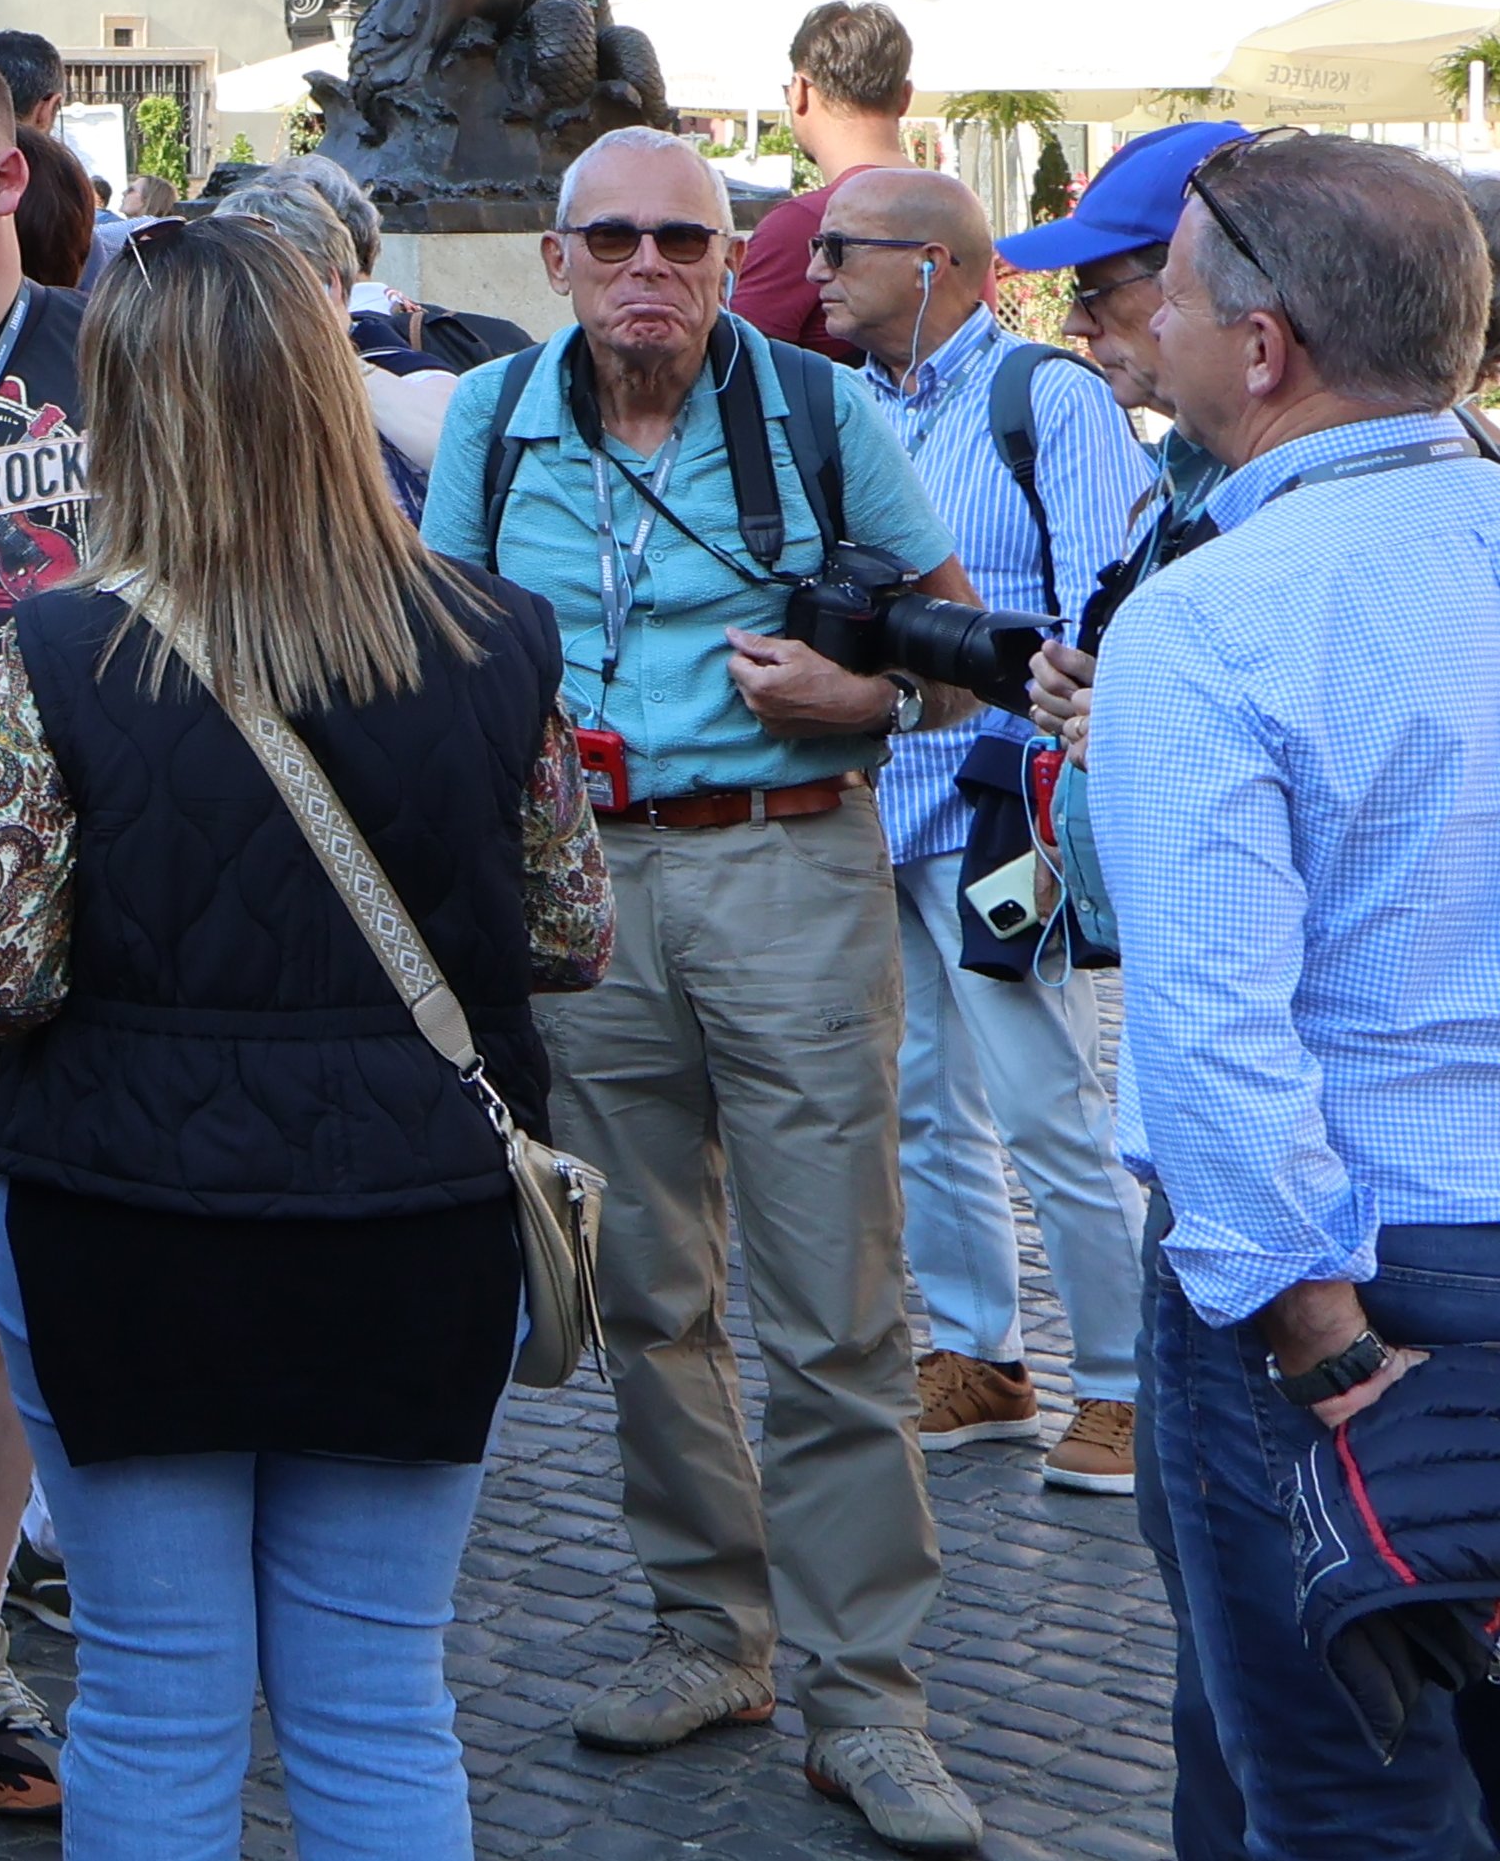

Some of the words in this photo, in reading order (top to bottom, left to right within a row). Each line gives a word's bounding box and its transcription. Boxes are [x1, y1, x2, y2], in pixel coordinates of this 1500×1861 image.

[9, 300, 26, 331] GUIDESET
[632, 519, 650, 556] GUIDESET
[603, 555, 613, 592] GUIDESET
